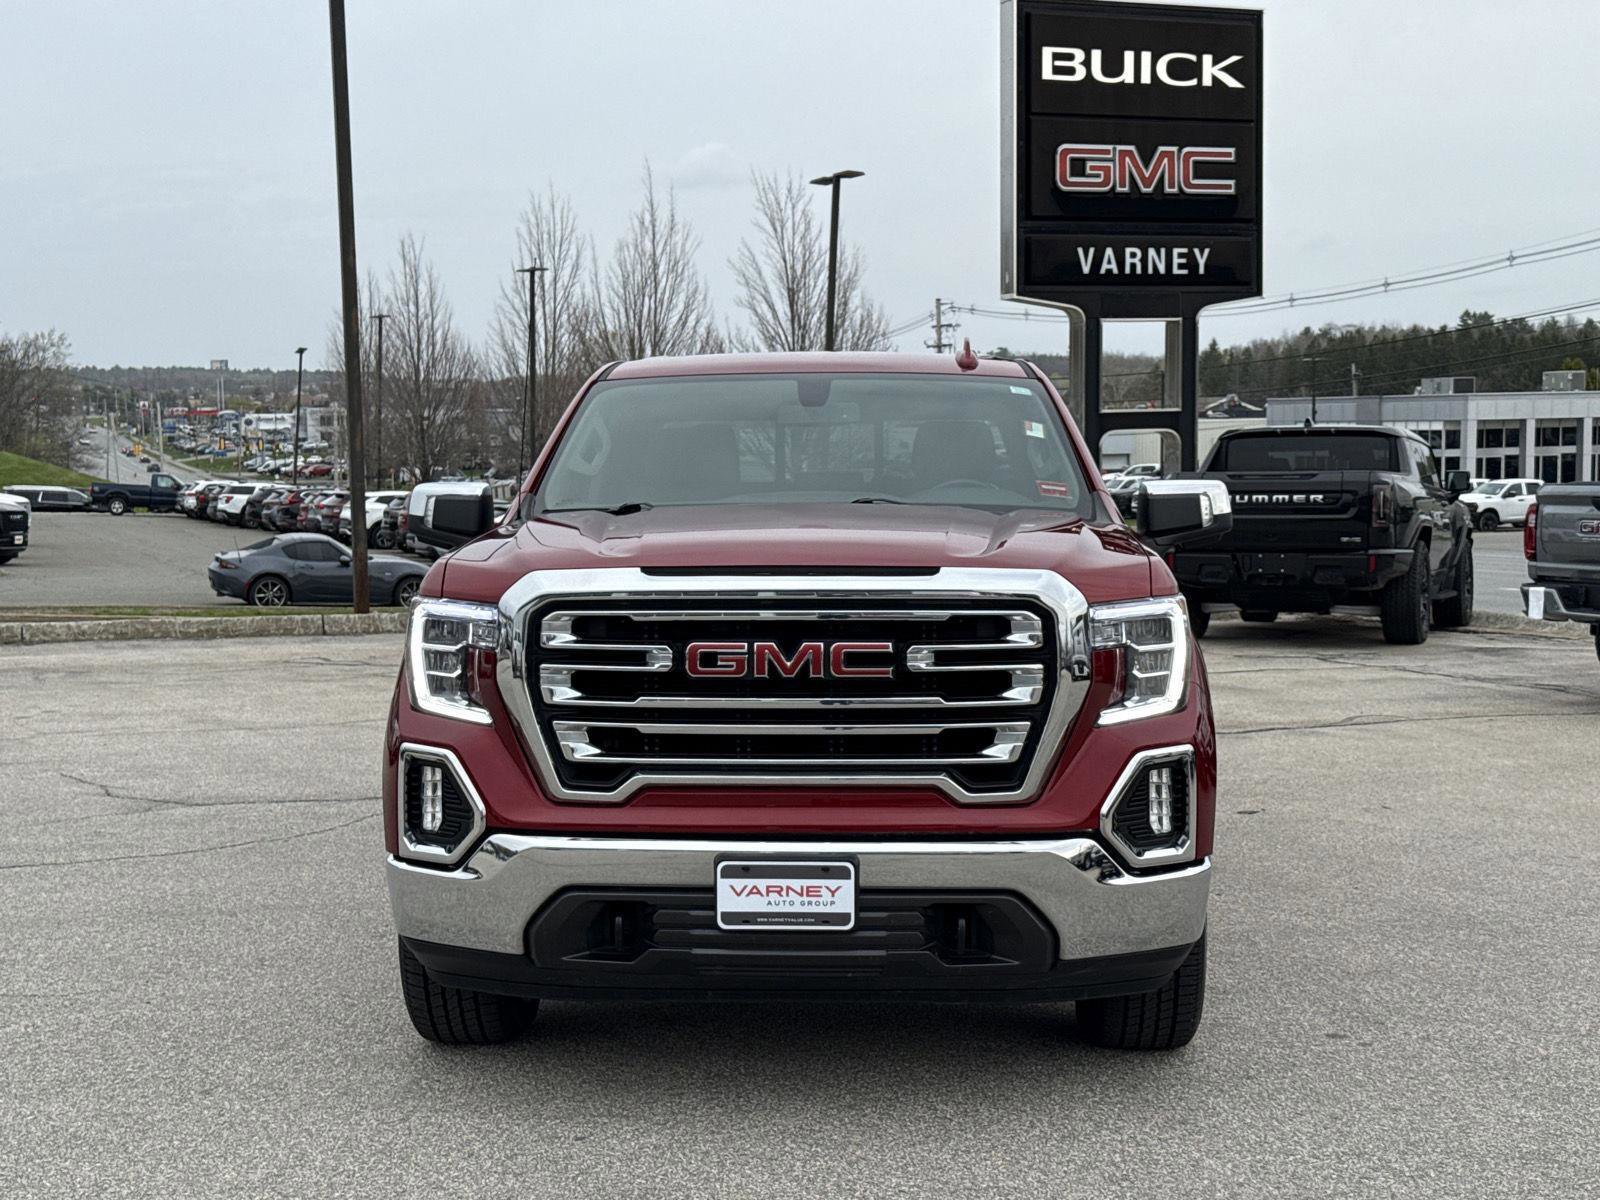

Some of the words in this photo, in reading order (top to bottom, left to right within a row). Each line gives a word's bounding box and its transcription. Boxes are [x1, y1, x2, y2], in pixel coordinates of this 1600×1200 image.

[1041, 46, 1245, 89] BUICK
[1055, 143, 1236, 194] GMC
[1077, 247, 1210, 275] VARNEY
[1228, 494, 1324, 503] UMMER
[685, 641, 894, 679] GMC
[730, 885, 842, 897] VARNEY
